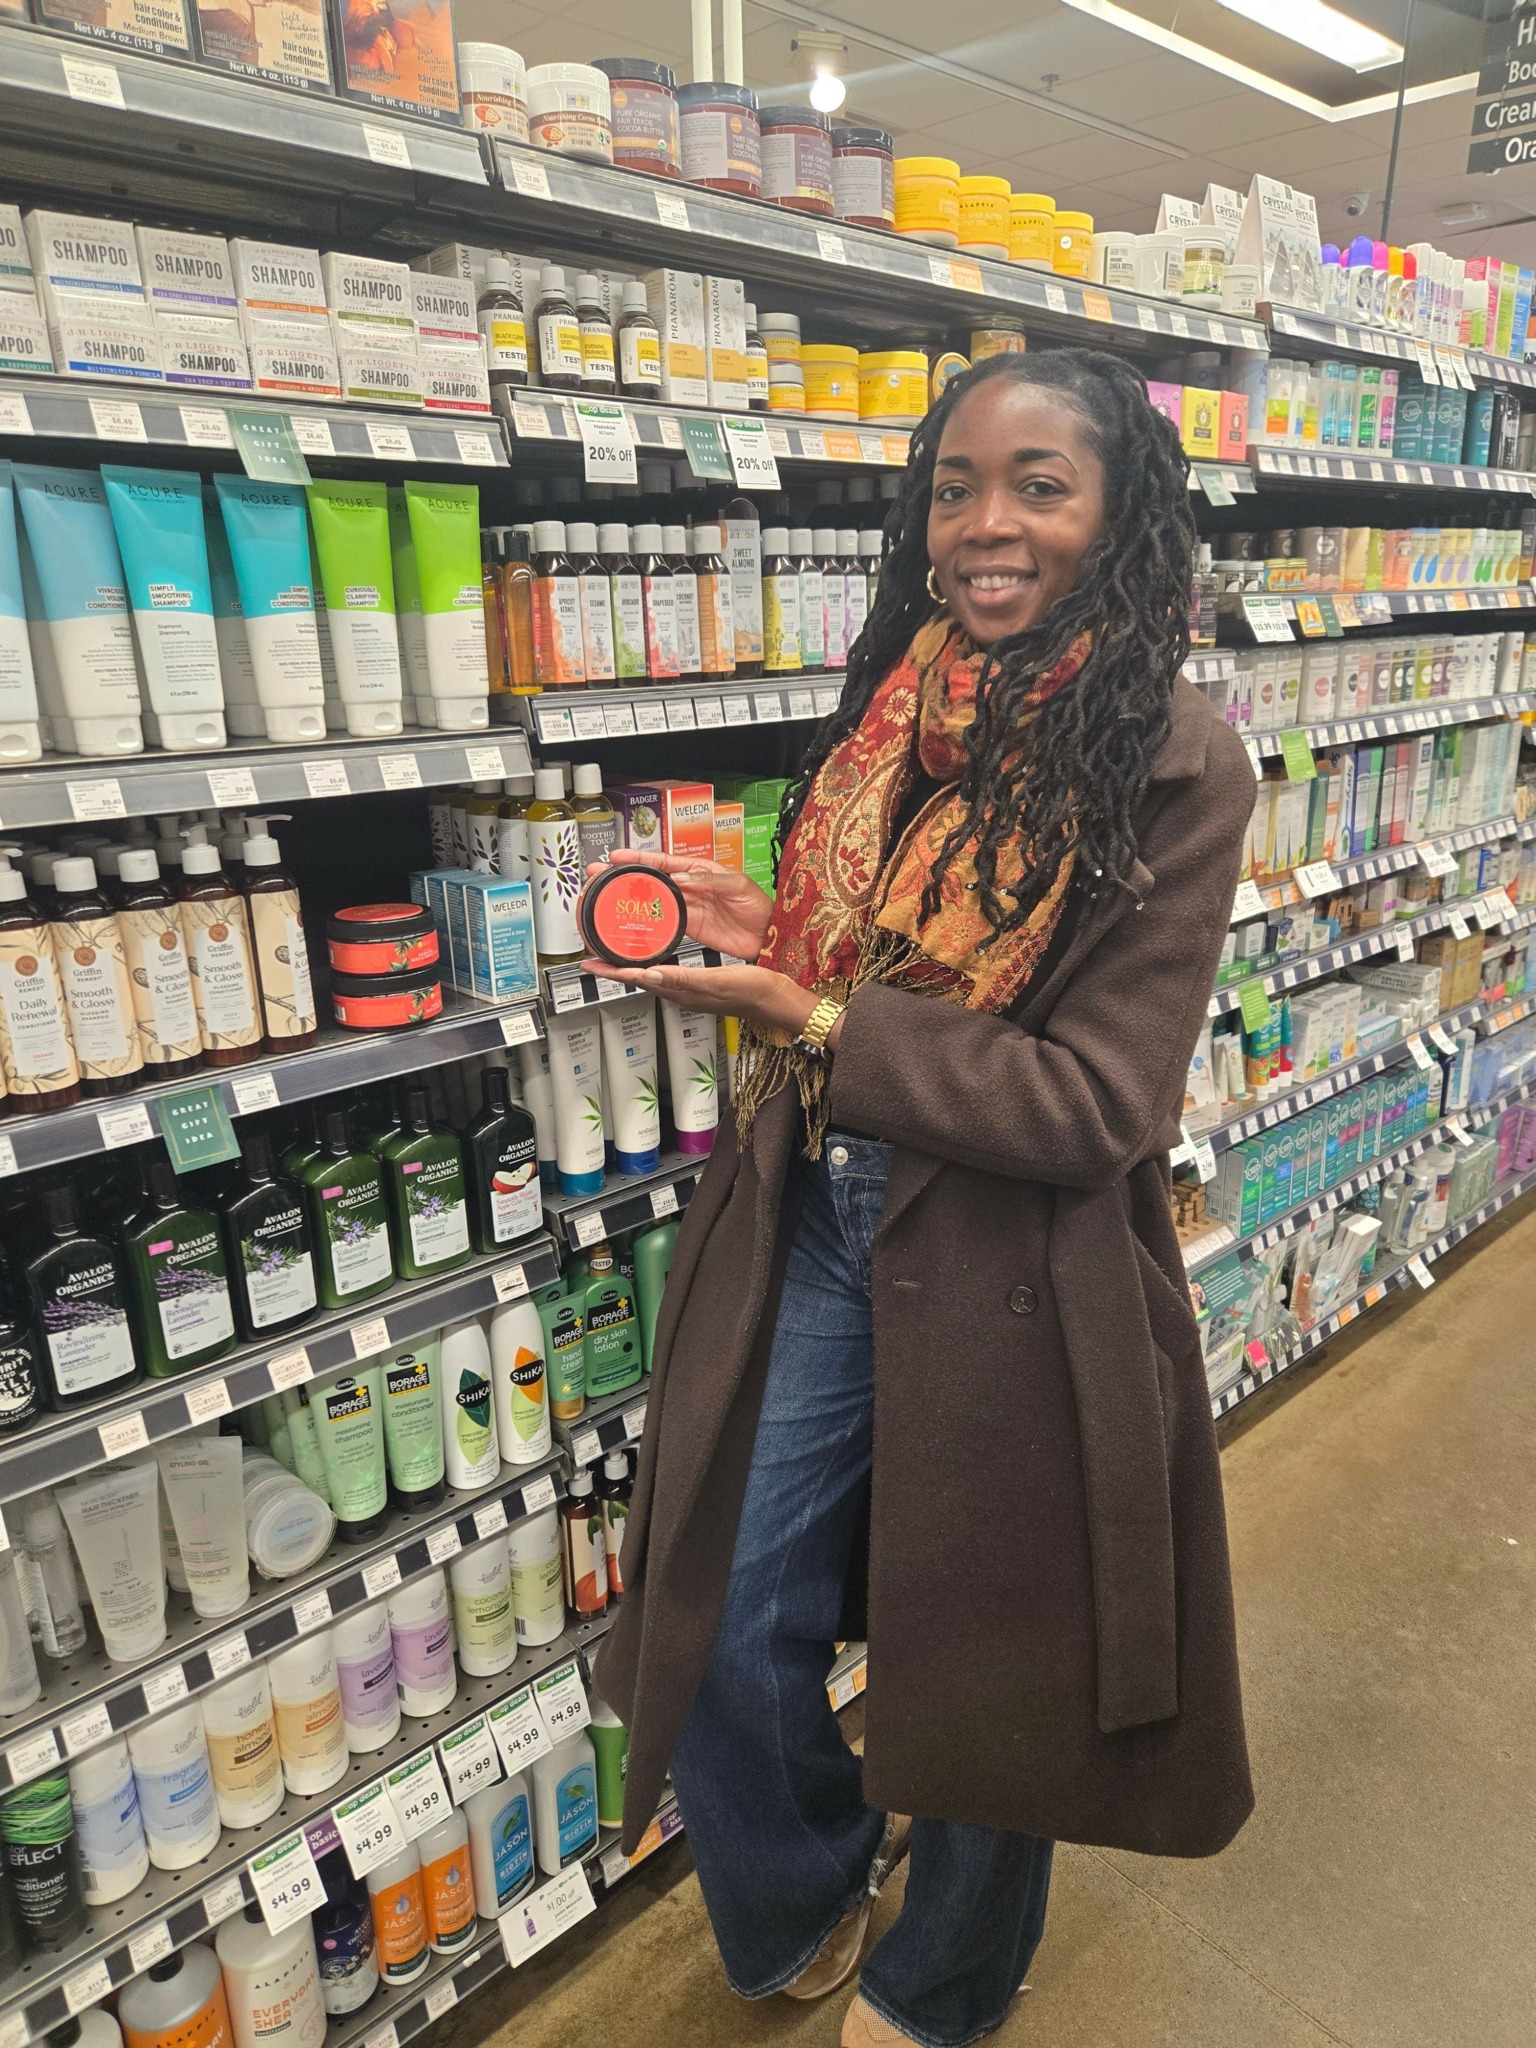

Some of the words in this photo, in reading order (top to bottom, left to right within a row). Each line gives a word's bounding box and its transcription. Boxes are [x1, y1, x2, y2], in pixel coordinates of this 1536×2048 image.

[133, 1, 151, 14] hair
[152, 7, 173, 21] color
[74, 22, 90, 33] Net
[91, 27, 108, 38] Wt.
[111, 31, 117, 40] 4
[118, 34, 133, 44] oz.
[135, 36, 153, 50] (113
[154, 43, 164, 54] g)
[123, 22, 156, 39] Medium
[159, 32, 185, 46] Brown
[1517, 16, 1536, 46] H
[282, 40, 297, 51] hair
[298, 45, 317, 58] color
[283, 52, 326, 70] conditioner
[230, 61, 245, 72] Net
[246, 66, 260, 77] Wt.
[261, 70, 268, 79] 4
[268, 73, 282, 82] oz.
[282, 74, 299, 87] (113
[300, 78, 310, 90] g)
[304, 69, 328, 81] Brown
[386, 97, 399, 108] Wt.
[416, 105, 431, 117] (113
[1262, 195, 1293, 213] CRYSTAL
[52, 239, 129, 267] SHAMPOO
[154, 253, 223, 280] SHAMPOO
[251, 264, 316, 289] SHAMPOO
[416, 294, 470, 317] SHAMPOO
[83, 340, 145, 363] SHAMPOO
[180, 353, 237, 374] SHAMPOO
[272, 360, 325, 381] SHAMPOO
[432, 380, 477, 399] SHAMPOO
[112, 417, 133, 426] $8.49
[243, 423, 280, 434] GREAT
[253, 440, 279, 449] GIFT
[259, 455, 287, 464] IDEA
[589, 446, 617, 462] 20%
[618, 449, 633, 462] Off
[736, 456, 761, 470] 20%
[761, 458, 775, 471] Off
[44, 484, 101, 499] ACURE
[128, 484, 184, 499] ACURE
[241, 492, 292, 506] ACURE
[328, 495, 374, 508] ACURE
[427, 498, 470, 511] ACURE
[733, 548, 752, 559] SWEET
[731, 557, 755, 569] ALMOND
[150, 584, 174, 592] SIMPLY
[151, 591, 191, 599] SMOOTHING
[291, 586, 309, 594] SIMPLY
[345, 586, 376, 594] CURIOUSLY
[346, 593, 379, 601] CLARIFYING
[629, 795, 658, 806] BADGER
[674, 803, 711, 818] WELEDA
[590, 837, 615, 849] TOUCH
[491, 898, 528, 913] WELEDA
[615, 898, 662, 918] SOLA'S
[207, 942, 235, 955] Griffin
[73, 966, 104, 979] Griffin
[203, 960, 242, 975] Smooth
[204, 973, 212, 984] &
[213, 970, 245, 986] Glossy
[70, 985, 114, 1000] Smooth
[19, 996, 48, 1011] Daily
[71, 999, 78, 1009] &
[80, 997, 117, 1012] Glossy
[11, 1005, 58, 1022] Renewal
[621, 1011, 648, 1024] CannaCell
[567, 1028, 593, 1041] CannaCell
[622, 1021, 641, 1031] Botanical
[622, 1028, 634, 1038] Body
[635, 1025, 649, 1035] Lotion
[568, 1038, 587, 1049] Botanical
[569, 1045, 582, 1056] Body
[581, 1041, 594, 1050] Lotion
[172, 1101, 209, 1115] GREAT
[181, 1116, 209, 1129] GIFT
[185, 1132, 214, 1144] IDEA
[506, 1137, 535, 1154] AVALON
[498, 1145, 536, 1164] ORGANICS
[424, 1157, 458, 1174] AVALON
[416, 1165, 460, 1184] ORGANICS
[346, 1179, 379, 1198] AVALON
[337, 1187, 380, 1210] ORGANICS
[263, 1206, 302, 1227] AVALON
[253, 1215, 303, 1237] ORGANICS
[177, 1232, 217, 1252] AVALON
[166, 1241, 219, 1266] ORGANICS
[591, 1259, 612, 1269] TESTER
[67, 1262, 114, 1285] AVALON
[166, 1307, 201, 1325] Lavender
[591, 1306, 630, 1326] BORAGE
[592, 1314, 630, 1330] THERAPY
[554, 1326, 584, 1346] BORAGE
[594, 1335, 609, 1346] dry
[610, 1327, 628, 1341] skin
[56, 1342, 97, 1360] Lavender
[594, 1339, 620, 1355] lotion
[561, 1355, 584, 1372] cream
[562, 1348, 582, 1364] hand
[389, 1373, 429, 1390] BORAGE
[390, 1380, 429, 1395] THERAPY
[329, 1395, 370, 1416] BORAGE
[391, 1400, 436, 1419] conditioner
[395, 1396, 430, 1411] moisturizing
[334, 1427, 374, 1446] shampoo
[335, 1420, 372, 1438] moisturizing
[169, 1460, 196, 1469] STYLING
[197, 1459, 210, 1467] GEL
[555, 1665, 574, 1678] deals
[509, 1691, 528, 1707] deals
[550, 1701, 581, 1725] $4.99
[236, 1719, 267, 1745] honey
[508, 1727, 540, 1755] $4.99
[457, 1757, 491, 1784] $4.99
[404, 1791, 440, 1821] $4.99
[563, 1815, 594, 1843] BIOTIN
[356, 1824, 392, 1855] $4.99
[9, 1839, 67, 1867] EFLECT
[500, 1850, 528, 1880] BIOTIN
[16, 1871, 66, 1892] nditioner
[271, 1877, 311, 1910] $4.99
[546, 1893, 568, 1911] $1.00
[568, 1888, 577, 1899] off
[252, 1970, 316, 2019] EVERYDAY
[253, 2008, 293, 2030] SHEA
